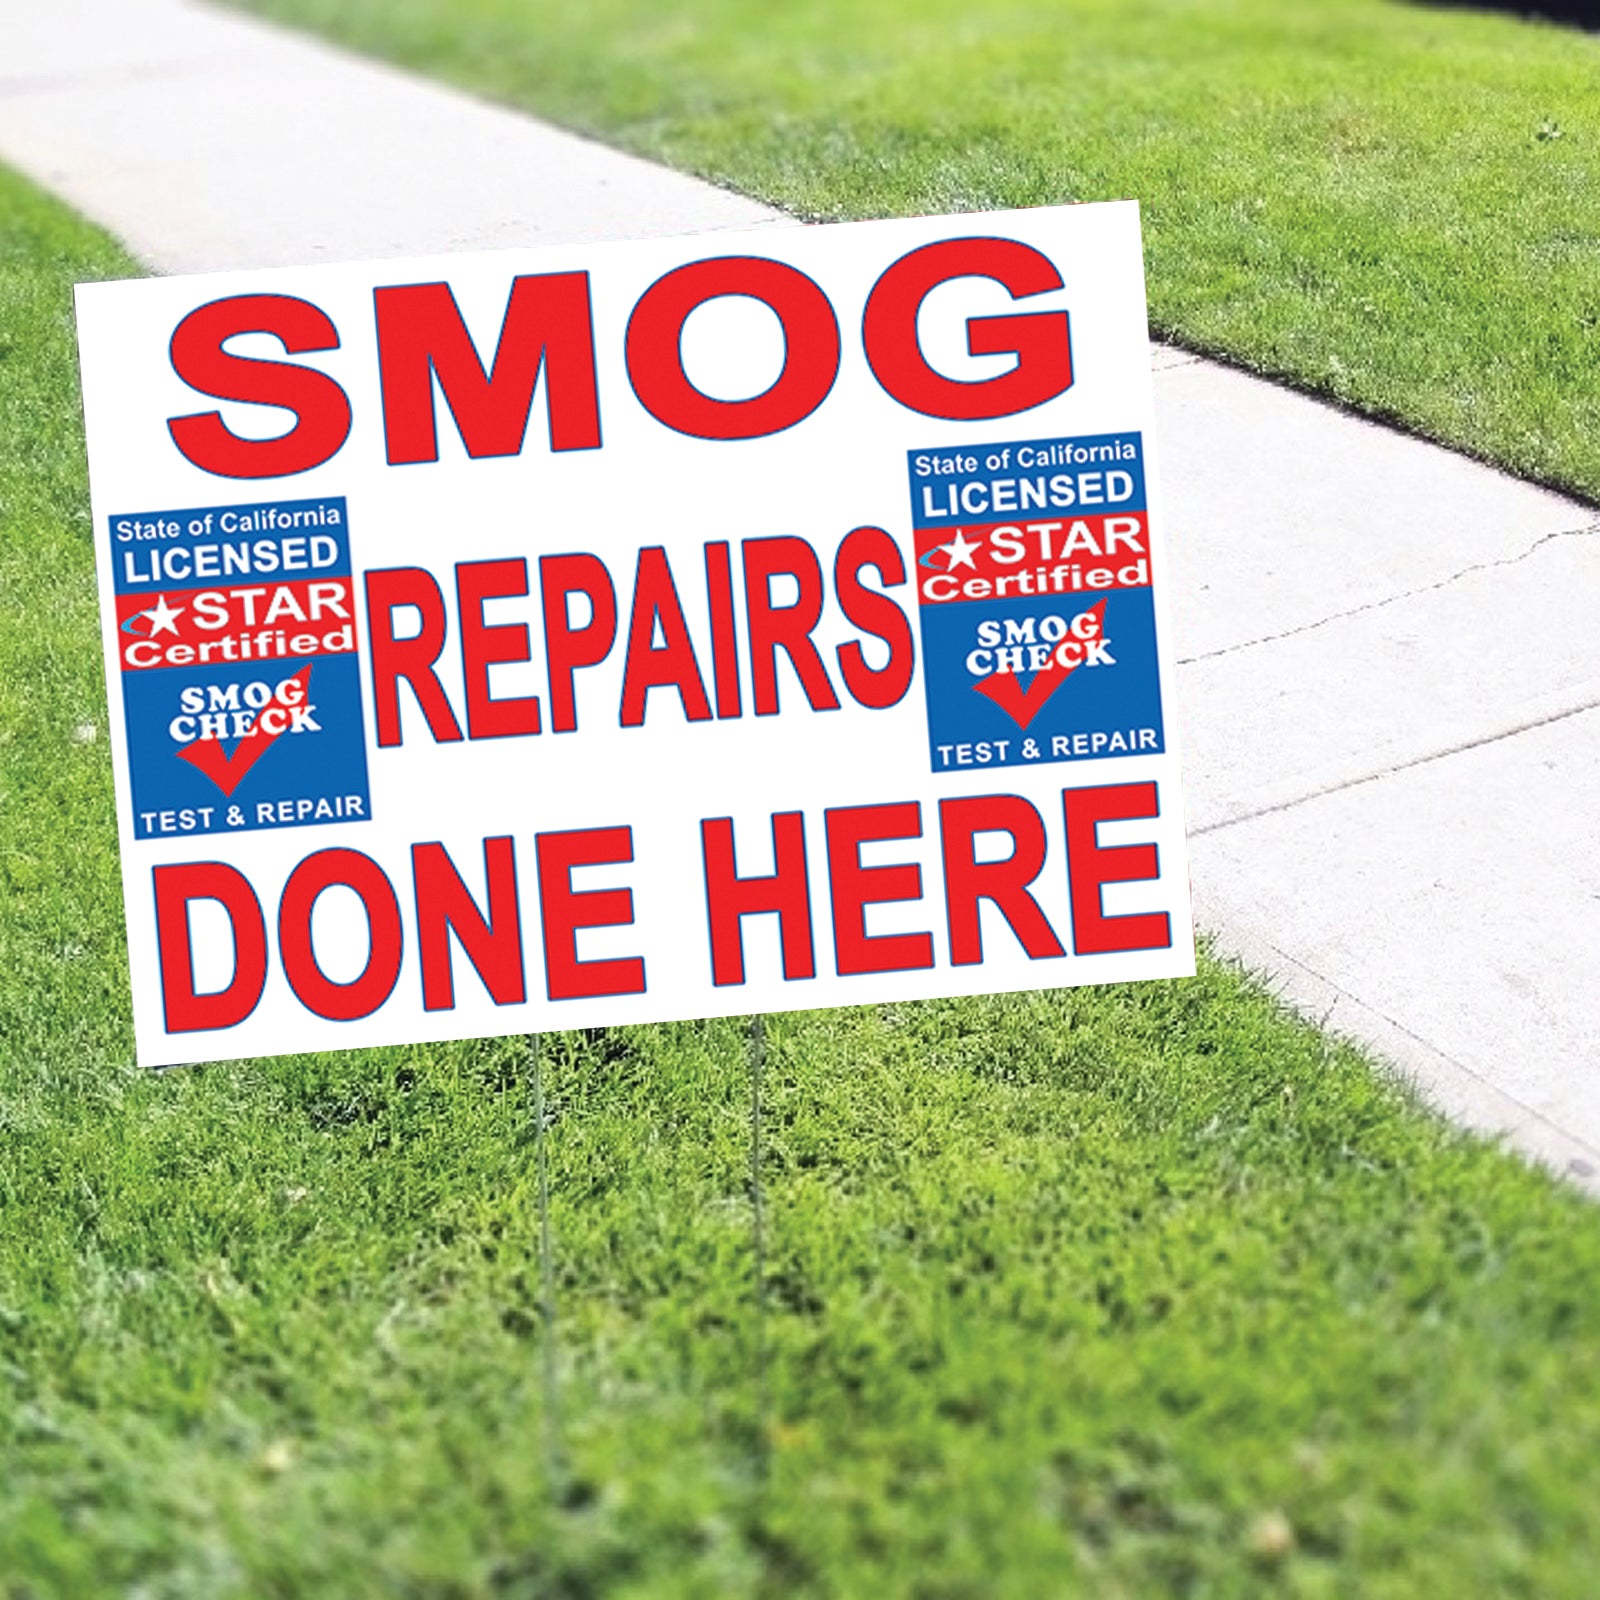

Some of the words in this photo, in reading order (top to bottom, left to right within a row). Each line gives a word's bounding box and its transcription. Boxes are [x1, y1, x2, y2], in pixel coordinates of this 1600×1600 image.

[166, 235, 1076, 480] SMOG
[915, 453, 978, 477] State
[986, 449, 1011, 471] of
[1017, 440, 1137, 468] California
[922, 470, 1134, 518] LICENSED
[116, 517, 180, 542] State
[188, 514, 213, 536] of
[220, 505, 341, 534] California
[989, 517, 1146, 564] STAR
[124, 535, 339, 583] LICENSED
[922, 559, 1149, 602] Certified
[192, 582, 351, 630] STAR
[124, 624, 354, 667] Certified
[363, 524, 916, 750] REPAIRS
[977, 613, 1100, 648] SMOG
[966, 638, 1117, 676] CHECK
[180, 679, 305, 714] SMOG
[169, 705, 322, 742] CHECK
[937, 741, 1010, 766] TEST
[1021, 738, 1041, 760] &
[1052, 729, 1158, 757] REPAIR
[140, 808, 214, 834] TEST
[226, 805, 245, 827] &
[256, 796, 364, 824] REPAIR
[151, 826, 648, 1035] DONE
[700, 780, 1173, 988] HERE
